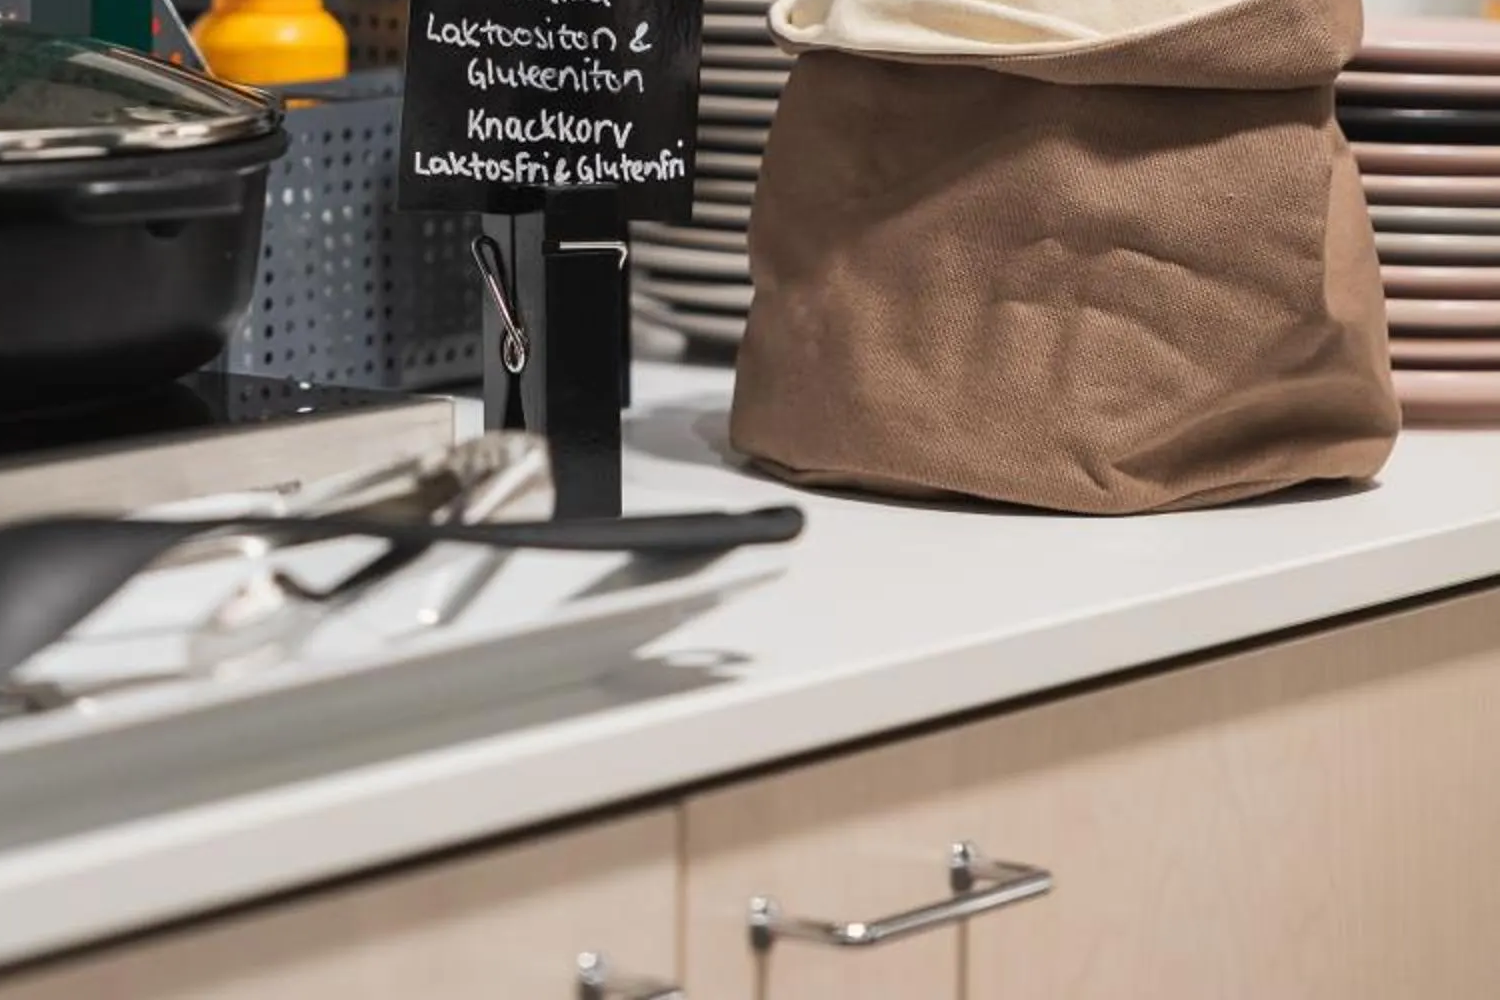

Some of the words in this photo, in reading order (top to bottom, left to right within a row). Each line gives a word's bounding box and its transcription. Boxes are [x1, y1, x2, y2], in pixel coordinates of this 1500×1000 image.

[426, 12, 617, 52] Laktoositon
[628, 21, 653, 53] &
[467, 56, 645, 93] Gluteeniton
[467, 108, 633, 149] Knackkorv
